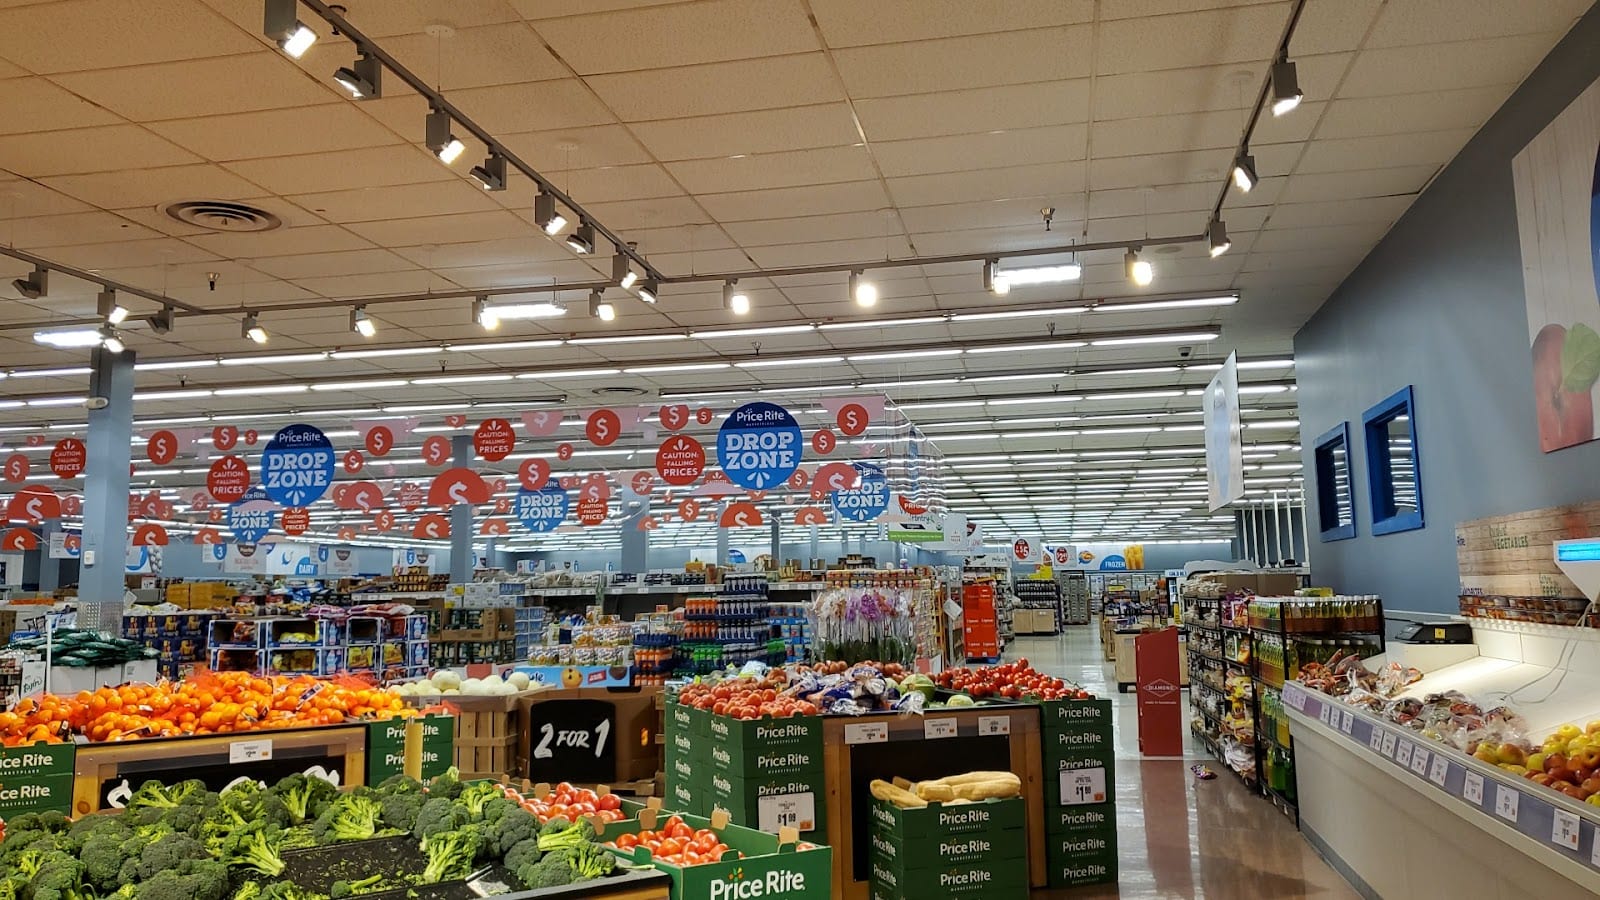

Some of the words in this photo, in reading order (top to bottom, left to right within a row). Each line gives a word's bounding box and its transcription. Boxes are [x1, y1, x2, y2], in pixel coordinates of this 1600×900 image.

[736, 411, 763, 422] Price
[765, 410, 785, 420] Rite
[279, 432, 302, 443] Price
[303, 431, 321, 441] Rite
[726, 432, 794, 451] DROP
[479, 445, 509, 453] PRICES
[268, 452, 328, 470] DROP
[726, 451, 795, 469] ZONE
[54, 463, 80, 471] PRICES
[663, 468, 698, 476] PRICES
[267, 470, 327, 488] ZONE
[213, 486, 243, 494] PRICES
[520, 495, 563, 507] DROP
[838, 495, 884, 508] ZONE
[520, 507, 564, 519] ZONE
[231, 517, 270, 529] ZONE
[217, 546, 223, 557] 3
[298, 564, 314, 574] DAIRY
[1059, 707, 1082, 718] Price
[1083, 706, 1100, 717] Rite
[387, 727, 406, 738] Pric
[422, 725, 440, 735] ite
[757, 727, 785, 739] Price
[787, 725, 808, 736] Rite
[1059, 733, 1082, 744] Price
[1084, 732, 1102, 743] Rite
[534, 723, 554, 759] 2
[556, 730, 590, 748] FOR
[595, 718, 610, 758] 1
[23, 754, 53, 767] Rite
[386, 754, 405, 765] Pric
[421, 752, 438, 762] ite
[758, 756, 786, 768] Price
[788, 753, 809, 765] Rite
[21, 785, 51, 798] Rite
[940, 813, 967, 825] Price
[968, 810, 990, 822] Rite
[1061, 814, 1085, 825] Price
[1086, 812, 1104, 822] Rite
[940, 843, 968, 855] Price
[969, 840, 990, 852] Rite
[1063, 841, 1086, 853] Price
[1087, 839, 1105, 850] Rite
[941, 874, 968, 886] Price
[970, 870, 991, 882] Rite
[1064, 868, 1087, 879] Price
[1088, 865, 1106, 876] Rite
[710, 878, 763, 900] Price
[766, 870, 804, 895] Rite
